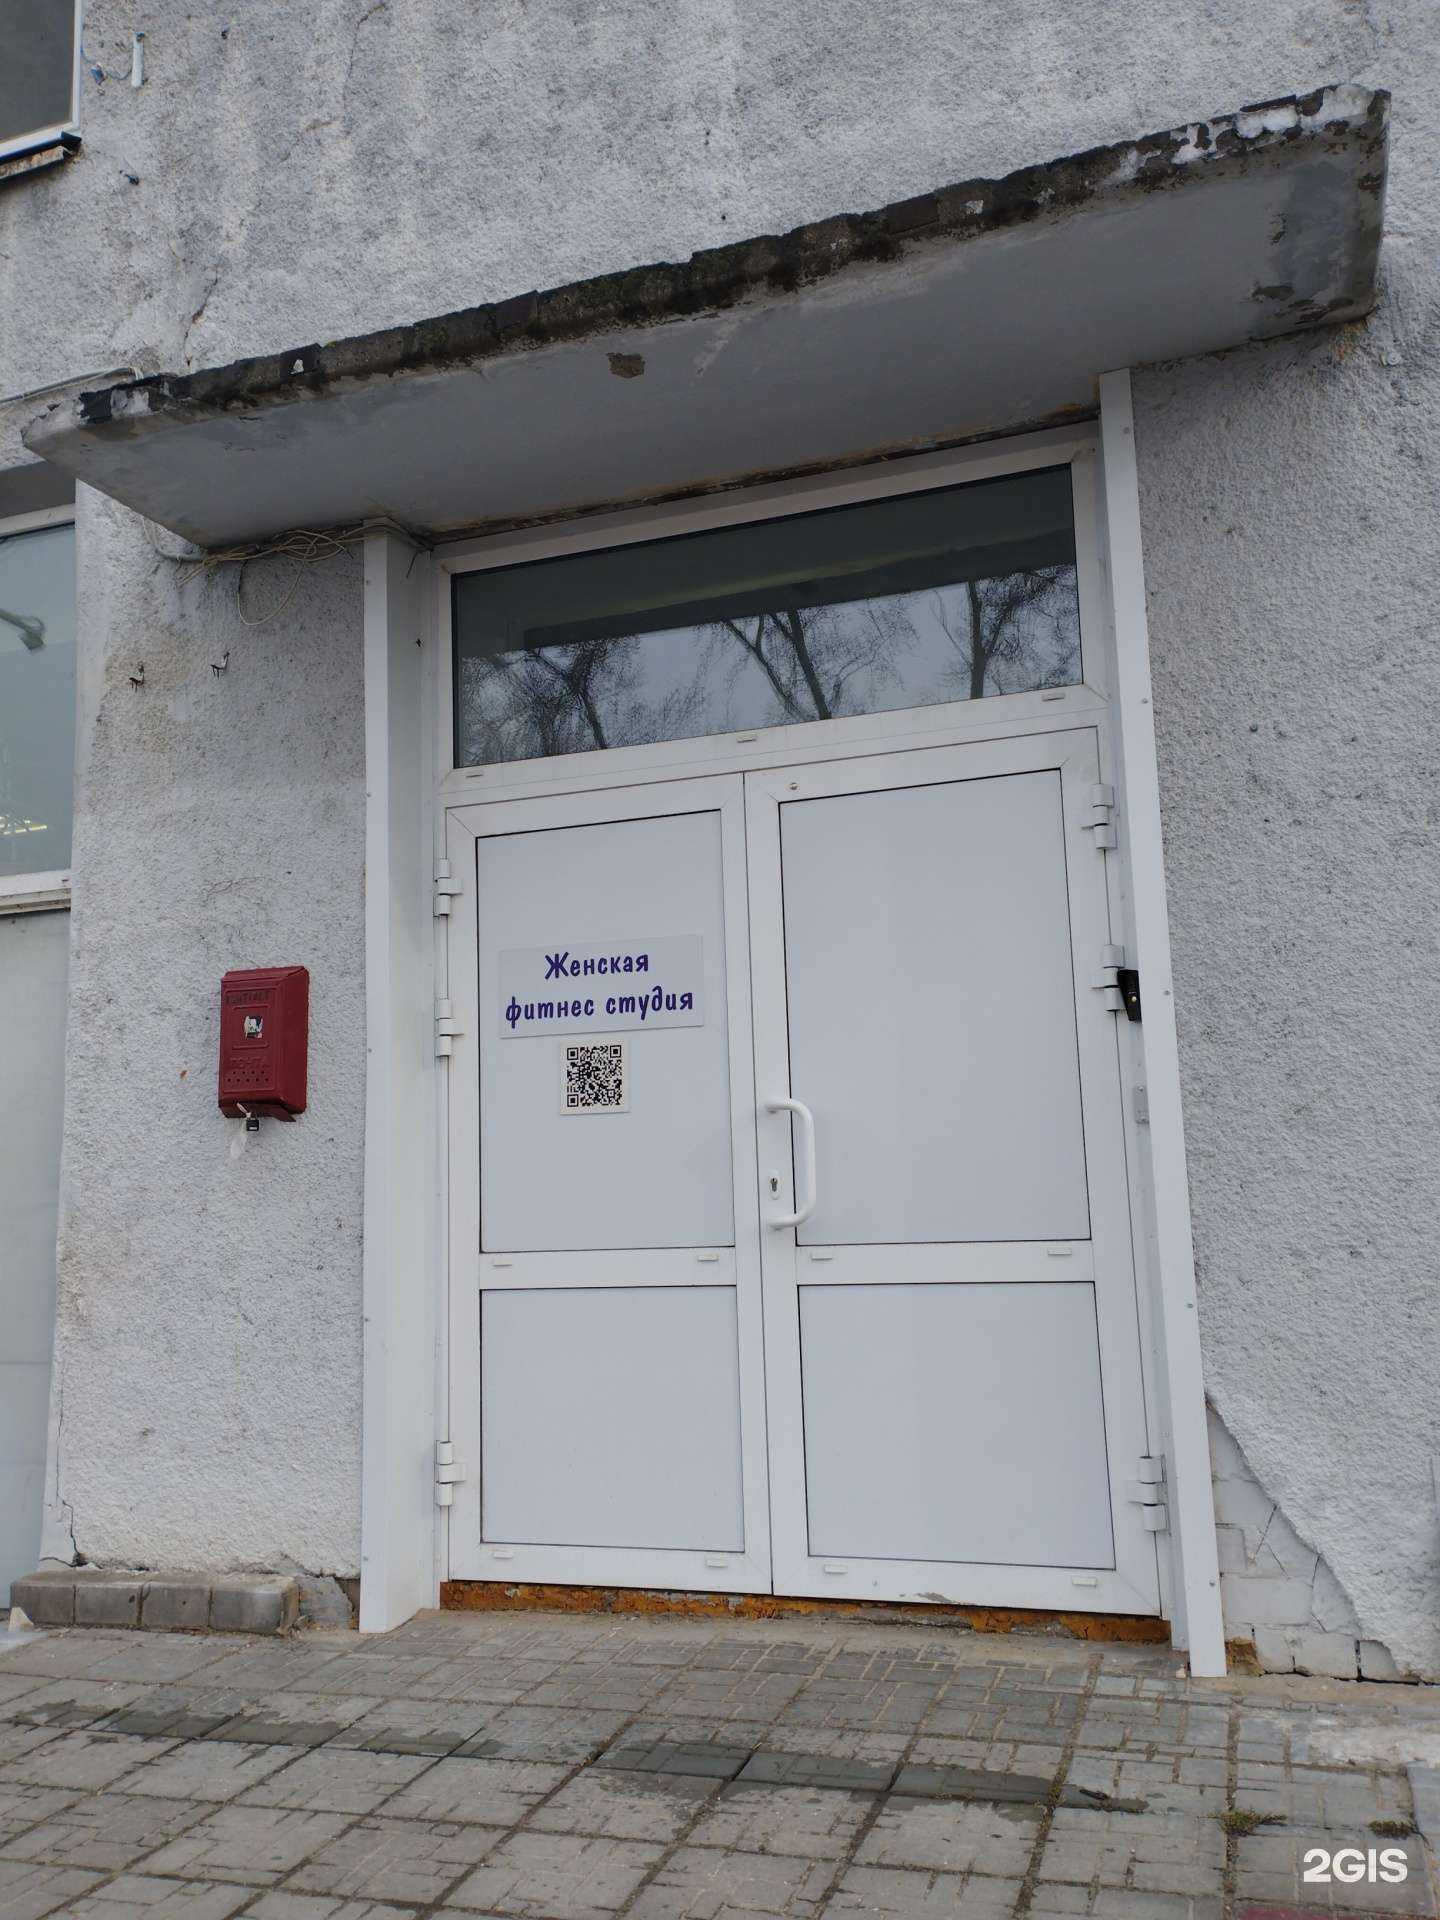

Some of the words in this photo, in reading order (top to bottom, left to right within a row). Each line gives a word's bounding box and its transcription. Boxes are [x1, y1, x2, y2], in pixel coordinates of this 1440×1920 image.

[544, 951, 649, 980] Женская
[505, 996, 595, 1029] фитнес
[605, 985, 693, 1021] студия
